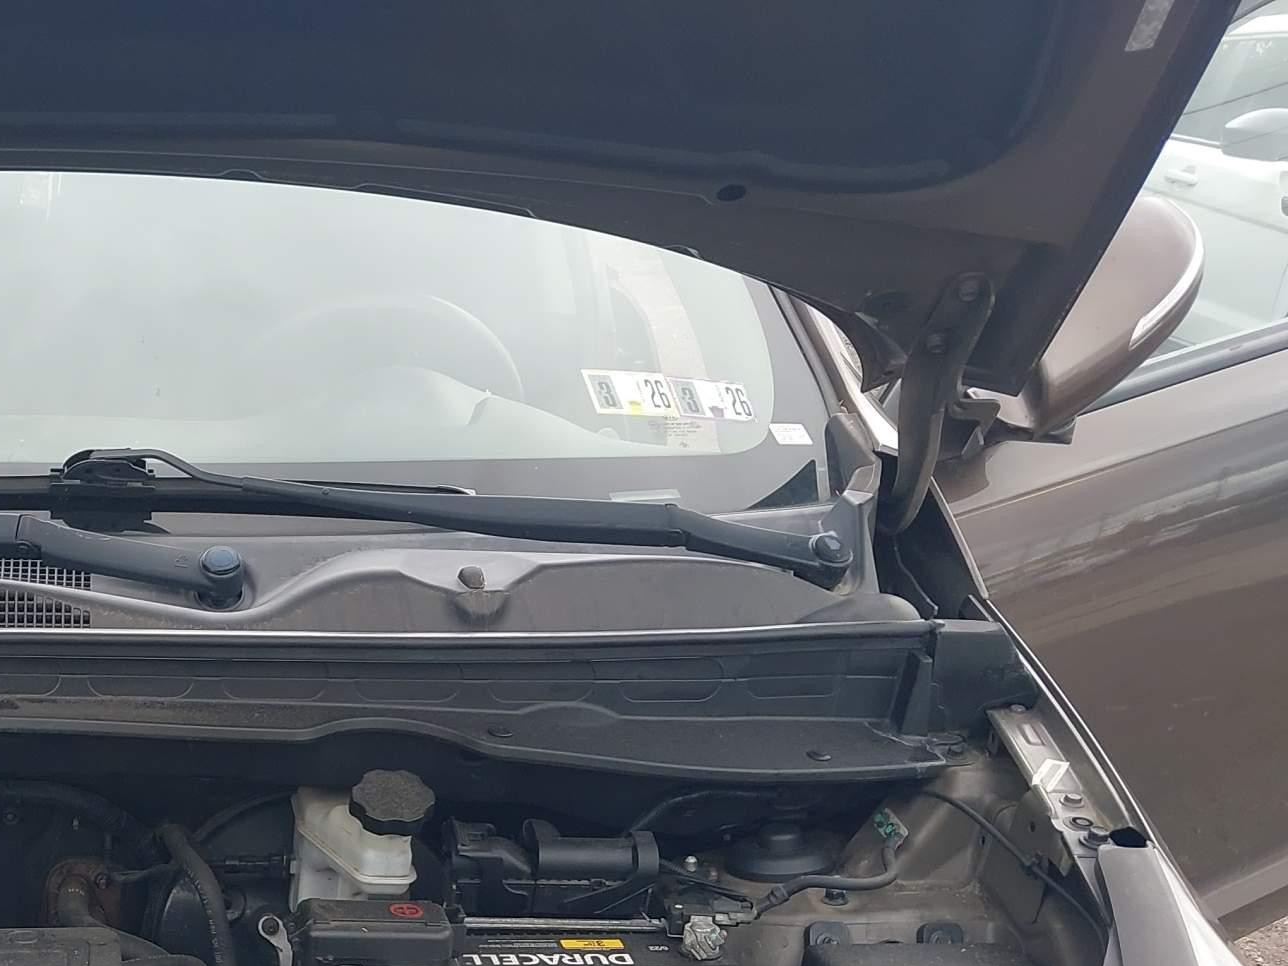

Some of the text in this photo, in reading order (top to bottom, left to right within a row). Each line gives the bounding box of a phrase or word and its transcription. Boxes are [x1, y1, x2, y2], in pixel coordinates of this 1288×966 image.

[597, 381, 618, 409] 3
[644, 378, 673, 410] 26
[724, 386, 753, 418] 26
[462, 953, 635, 966] DURACELL
